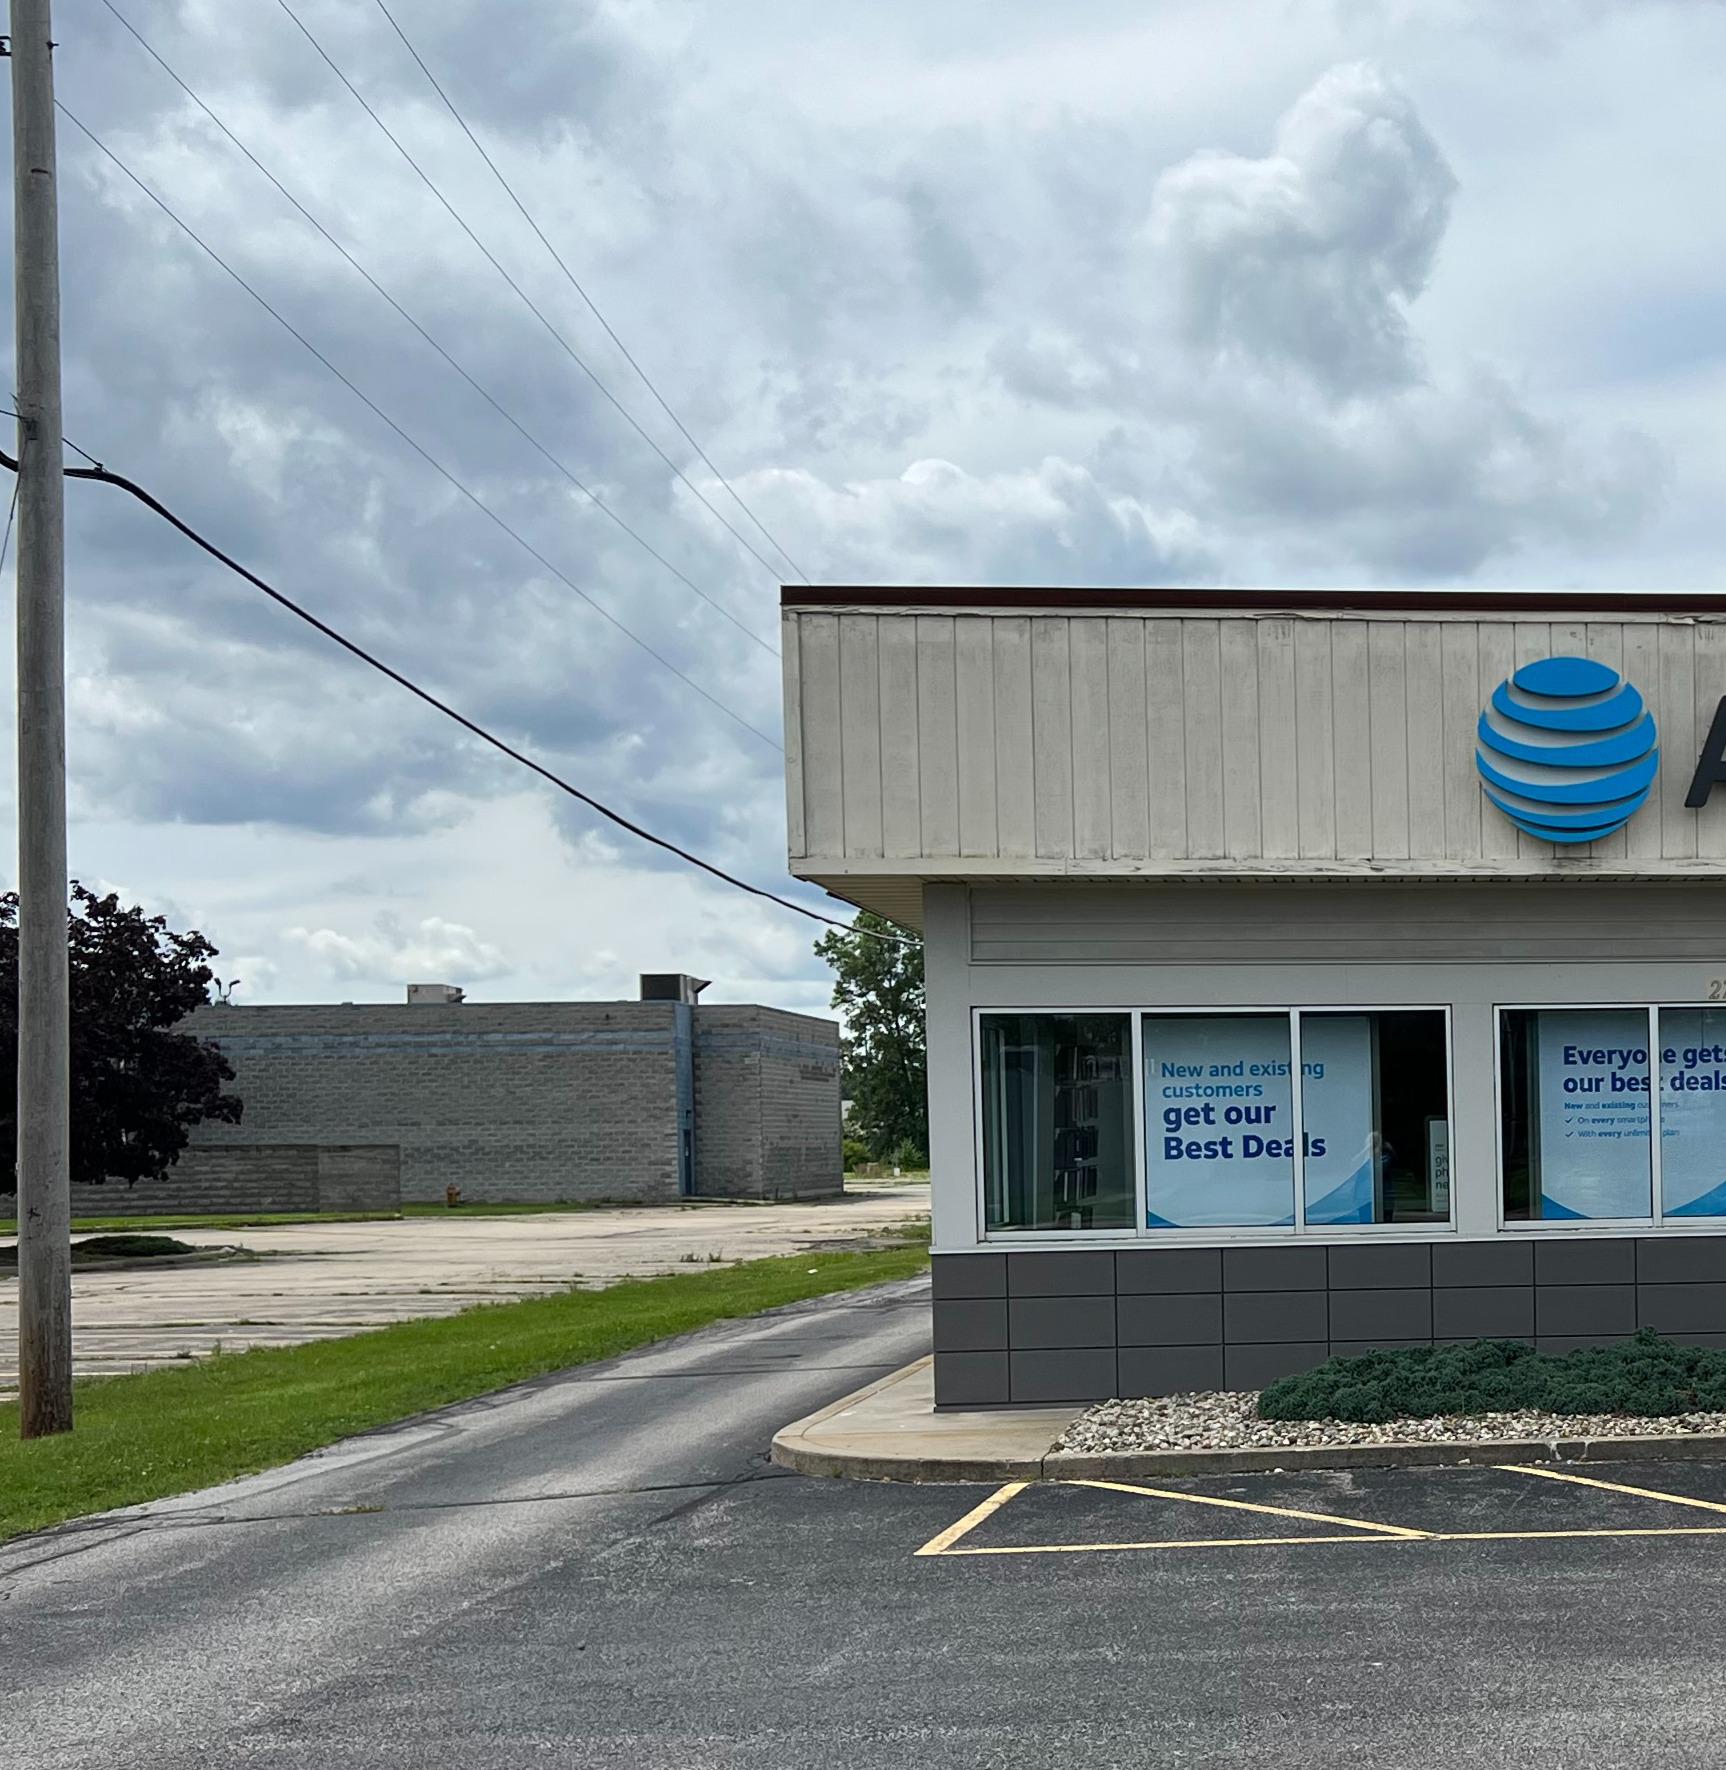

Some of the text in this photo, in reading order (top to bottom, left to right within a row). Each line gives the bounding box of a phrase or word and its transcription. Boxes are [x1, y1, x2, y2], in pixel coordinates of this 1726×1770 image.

[1563, 1045, 1677, 1070] Everyoe
[1161, 1060, 1324, 1080] New and existng
[1162, 1083, 1263, 1098] customers
[1563, 1076, 1605, 1093] our
[1585, 1101, 1600, 1109] and
[1163, 1103, 1276, 1133] get our
[1577, 1116, 1590, 1125] On
[1591, 1117, 1616, 1126] every
[1598, 1130, 1622, 1139] every
[1164, 1132, 1327, 1160] Best Deals
